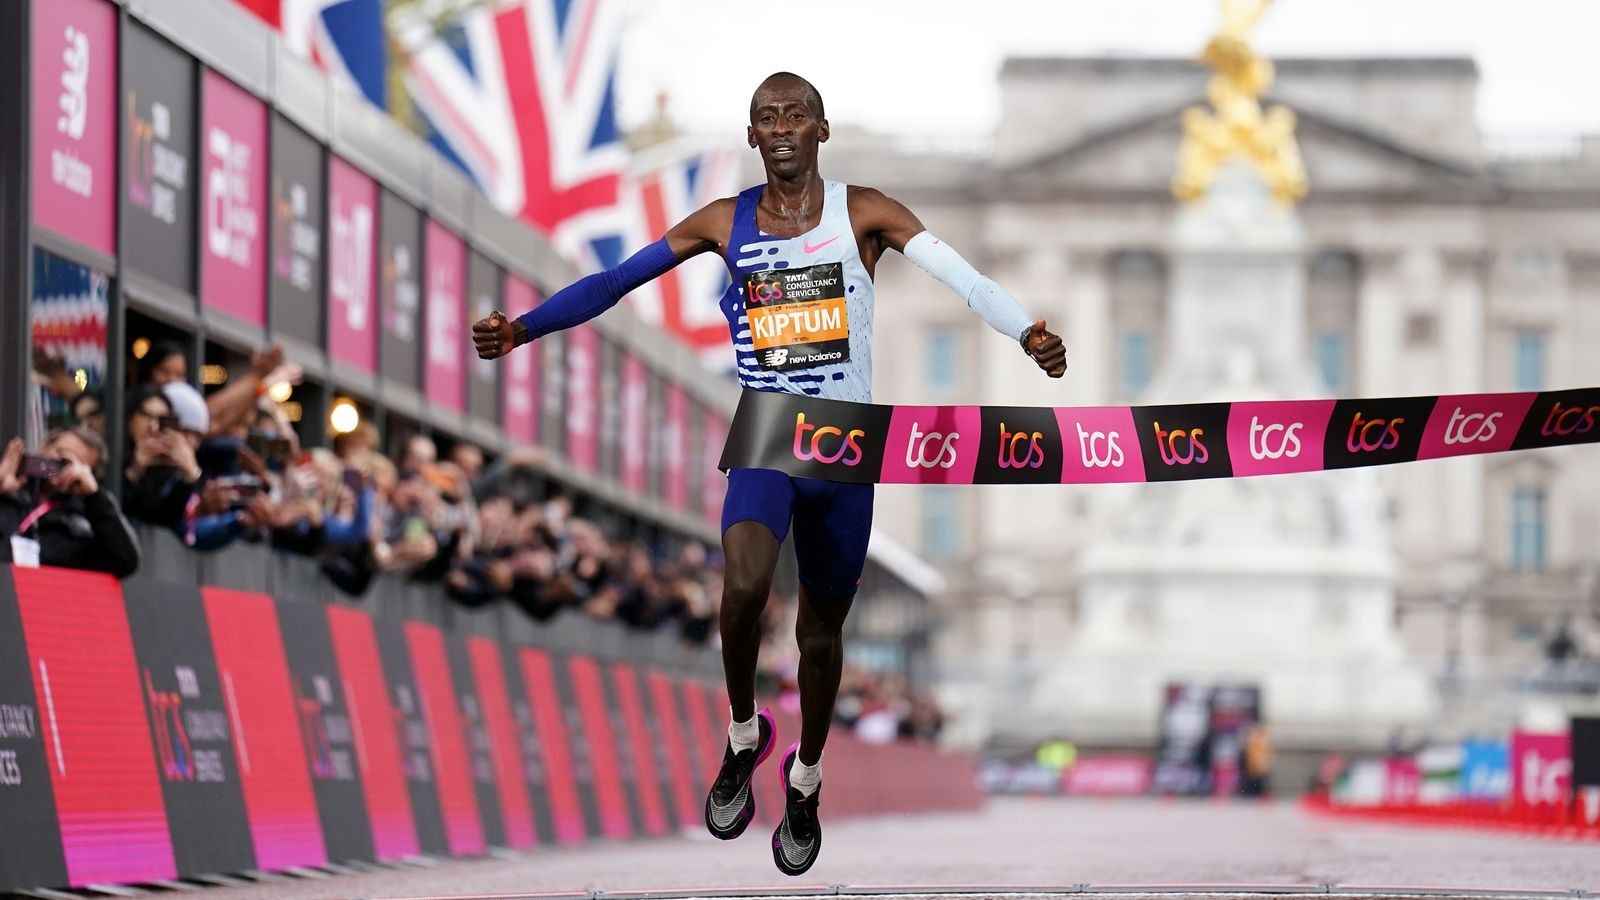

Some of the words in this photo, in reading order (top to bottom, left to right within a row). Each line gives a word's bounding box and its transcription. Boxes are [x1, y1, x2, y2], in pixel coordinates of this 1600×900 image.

[747, 281, 783, 303] tcs
[785, 273, 808, 282] TATA
[786, 278, 837, 291] CONSULTANCY
[787, 287, 821, 299] SERVICES
[753, 307, 842, 339] KIPTUM
[789, 354, 807, 364] new
[808, 351, 842, 362] balance
[1249, 415, 1304, 460] tcs
[1346, 411, 1405, 453] tcs
[1444, 406, 1503, 446] tcs
[1540, 401, 1600, 437] tcs
[792, 412, 865, 467] tcs
[905, 421, 960, 469] tcs
[999, 421, 1045, 469] tcs
[1076, 421, 1125, 469] tcs
[1153, 421, 1209, 466] tcs
